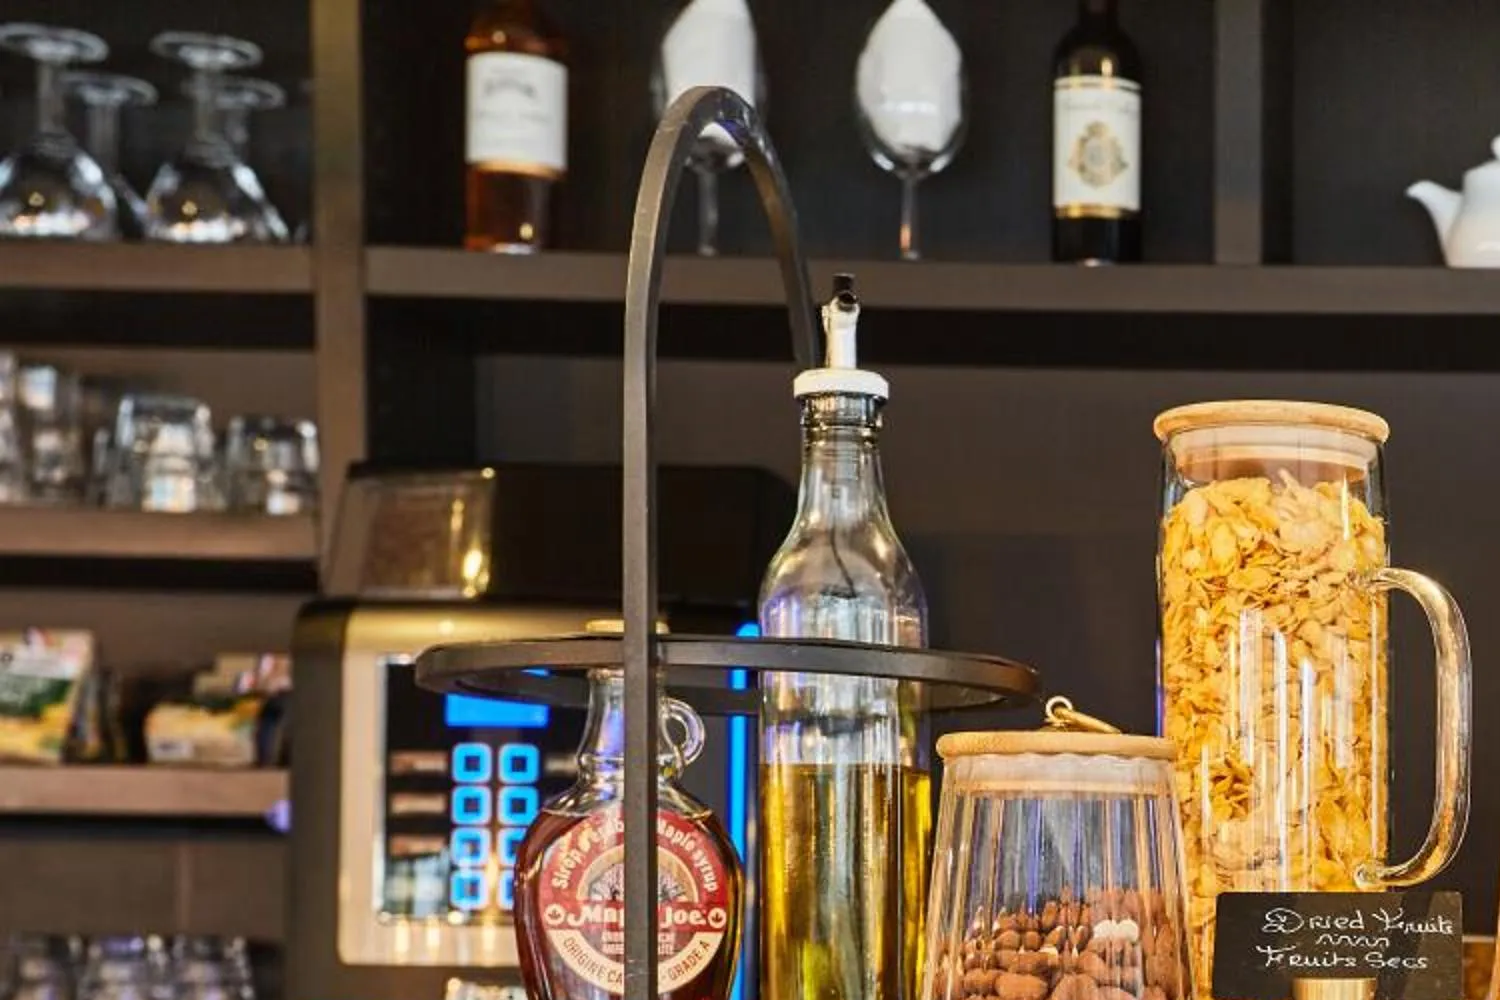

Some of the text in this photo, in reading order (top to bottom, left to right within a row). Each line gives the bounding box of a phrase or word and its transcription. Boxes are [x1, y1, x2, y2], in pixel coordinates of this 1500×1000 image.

[692, 849, 718, 892] syrup
[1262, 907, 1365, 934] Dried
[668, 939, 710, 981] GRADE A
[1364, 951, 1429, 969] Secs
